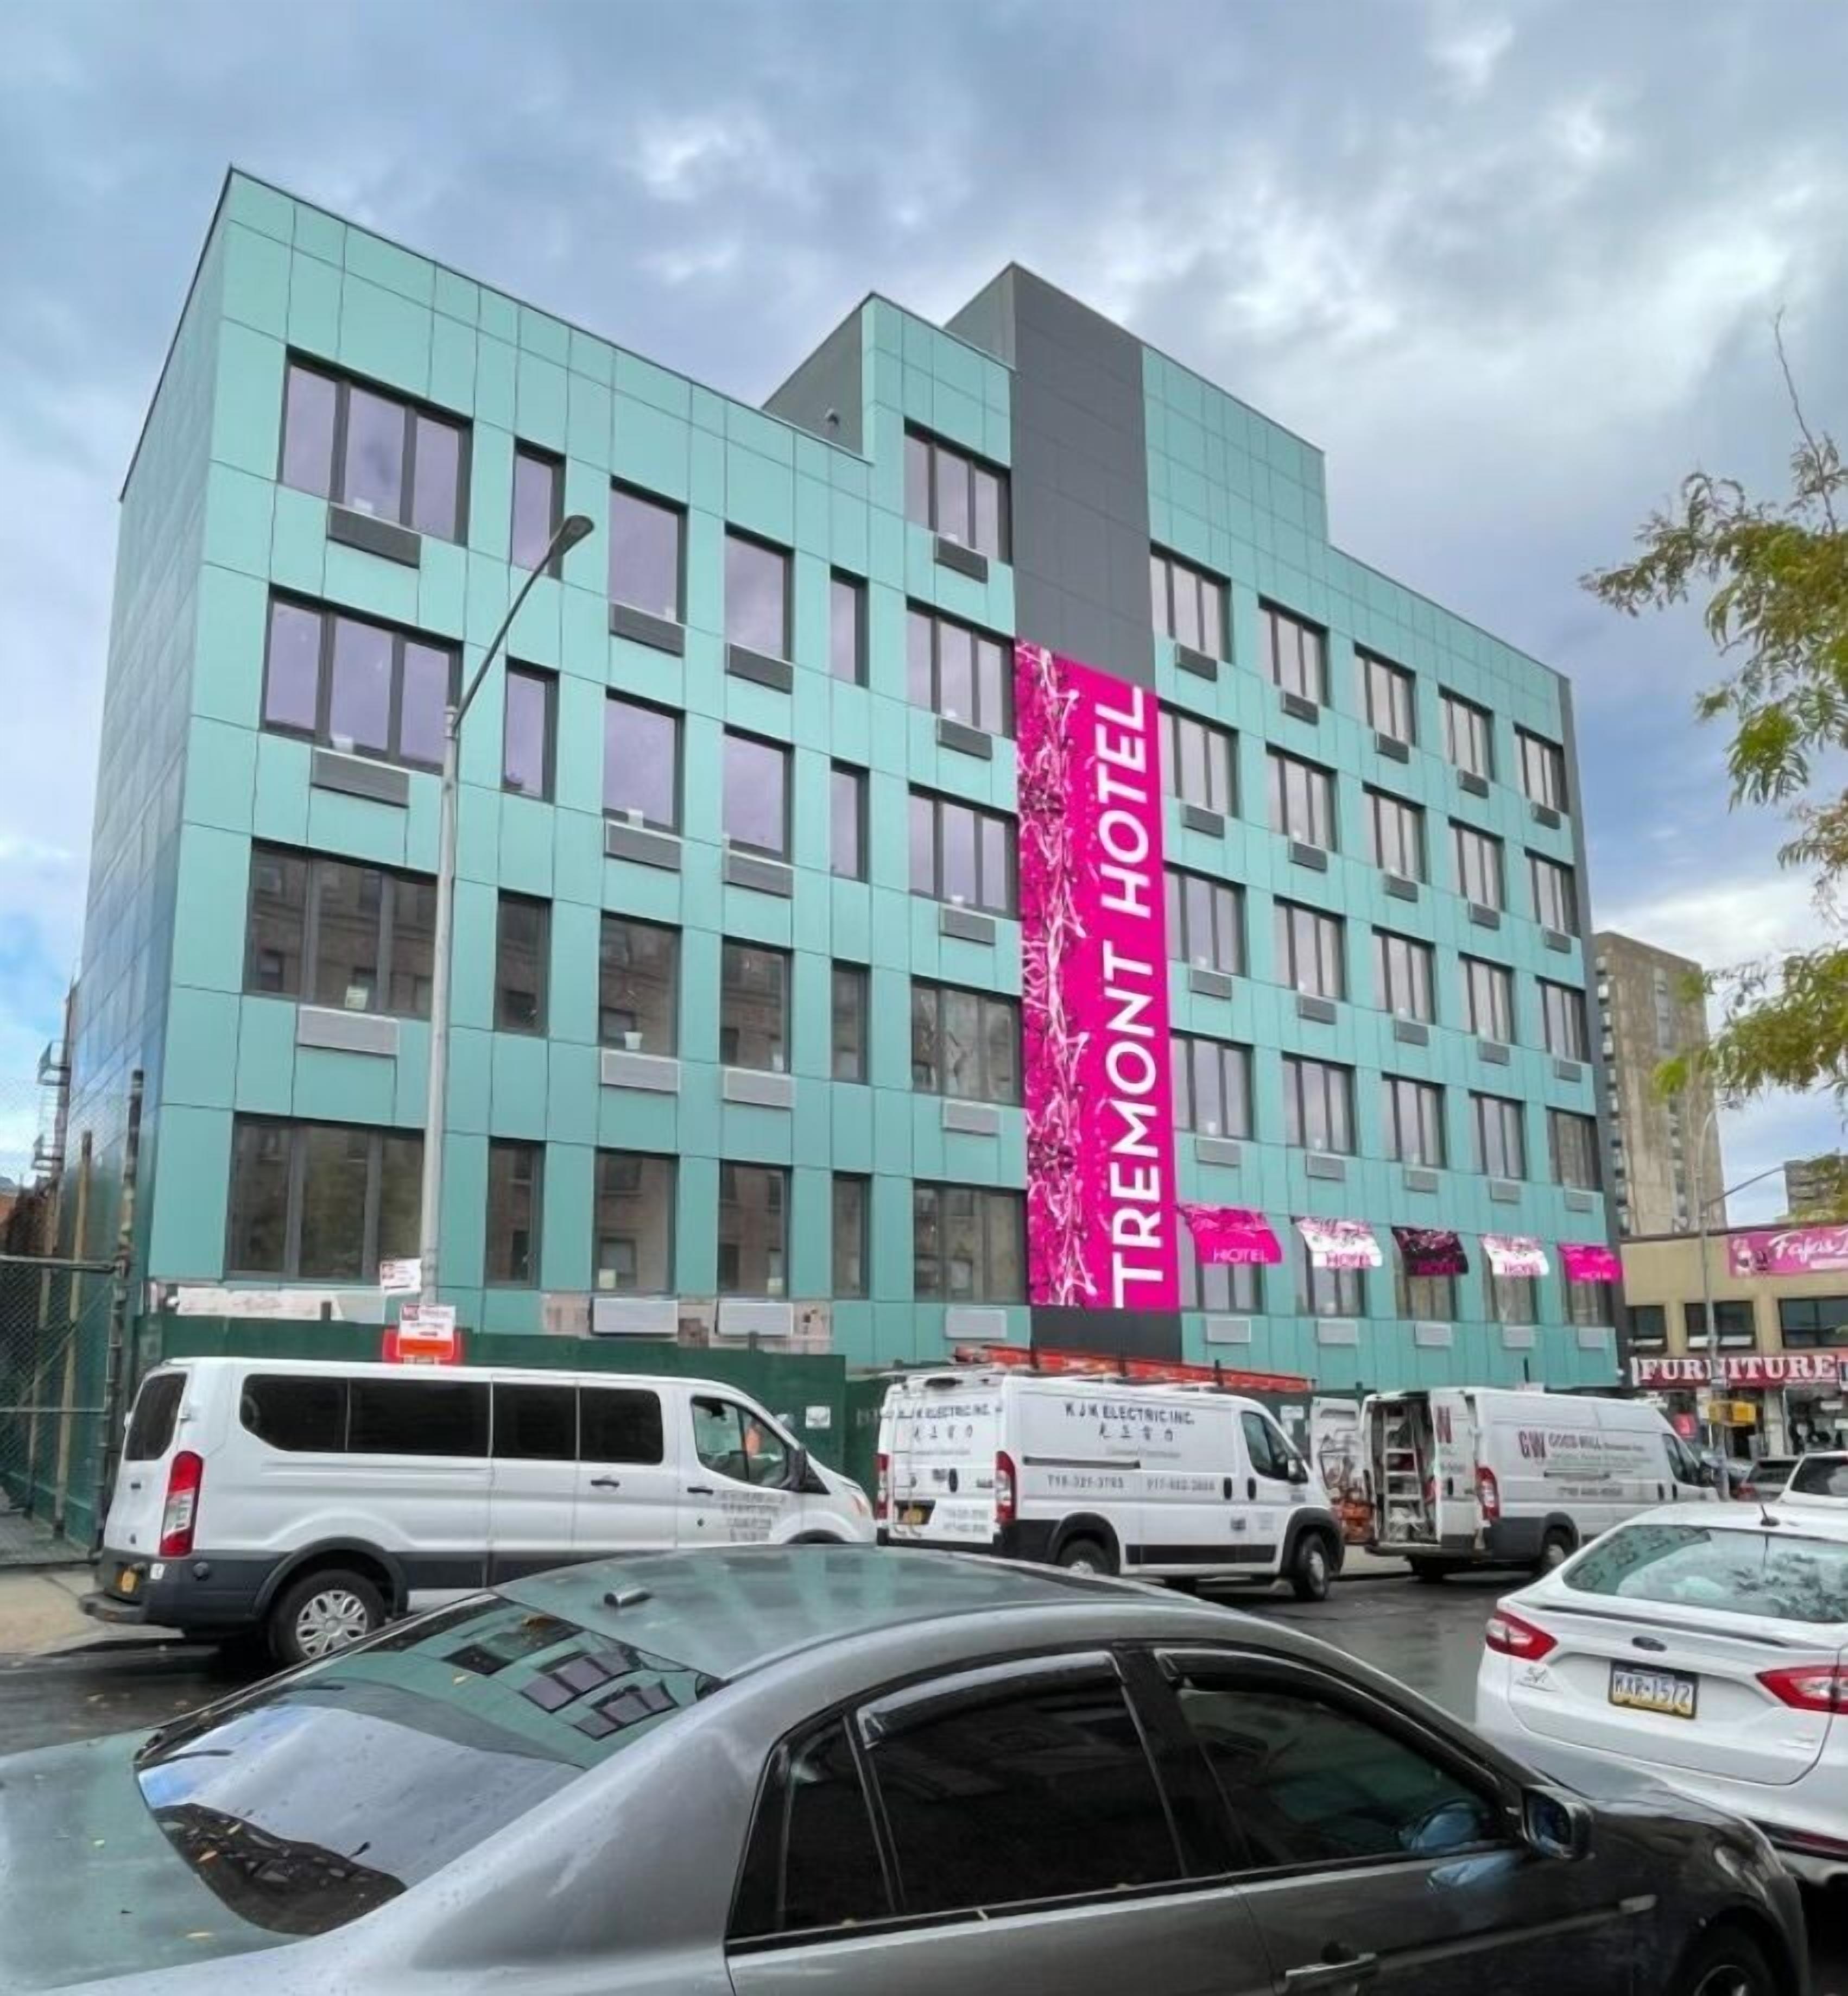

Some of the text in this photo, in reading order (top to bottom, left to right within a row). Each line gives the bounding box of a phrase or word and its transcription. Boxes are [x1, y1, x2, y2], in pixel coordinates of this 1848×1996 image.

[1095, 685, 1163, 1309] TREMONT HOTEL
[1213, 1247, 1269, 1263] HOTEL
[1640, 1355, 1836, 1380] FURNITURE
[1103, 1405, 1168, 1423] ELECTRIC
